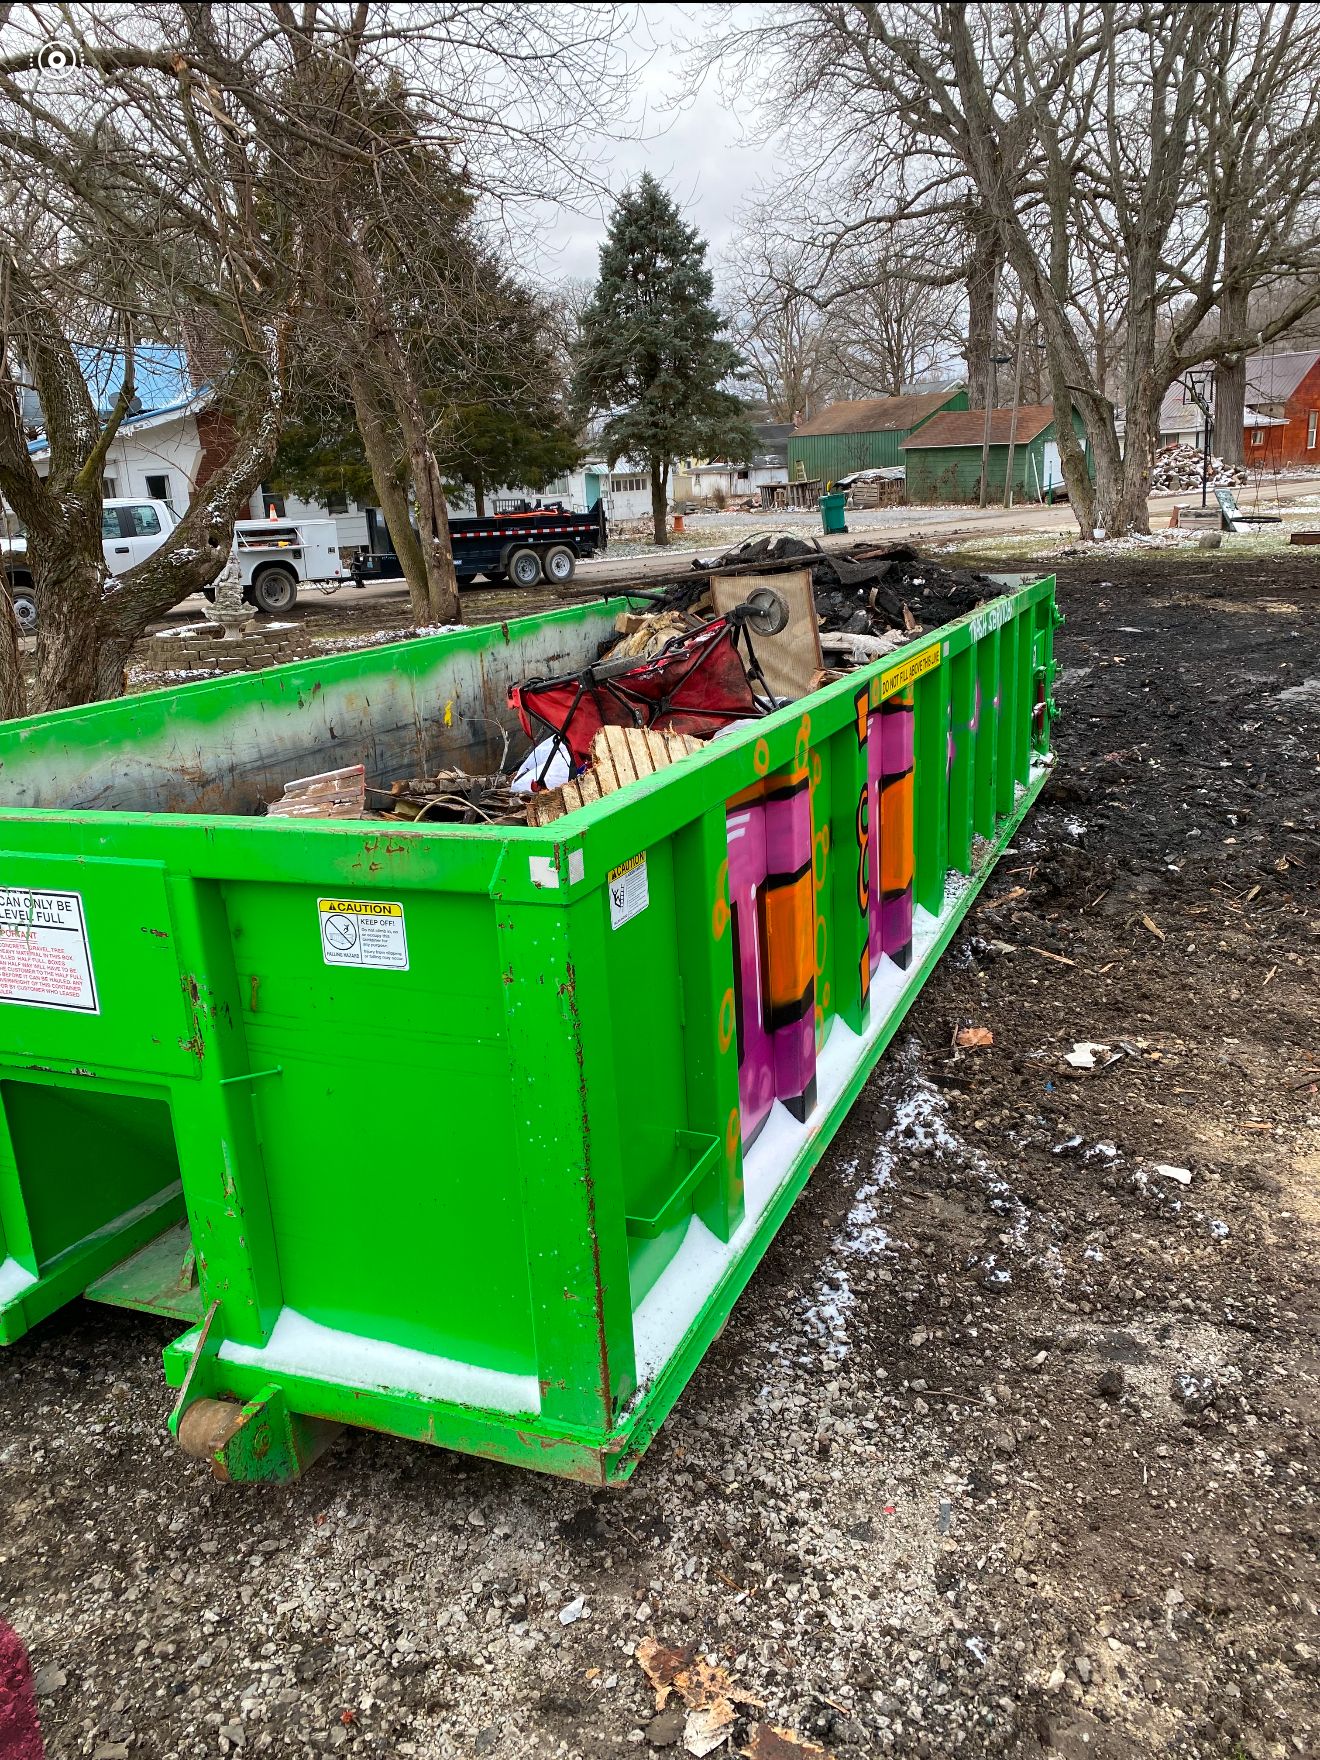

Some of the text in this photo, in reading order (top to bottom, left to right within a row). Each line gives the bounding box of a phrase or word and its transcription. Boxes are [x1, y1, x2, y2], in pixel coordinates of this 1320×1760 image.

[882, 650, 940, 694] DO NOT FILL ABOVE THIS LINE
[616, 850, 645, 876] CAUTION
[0, 896, 72, 912] CAN ONLY BE
[337, 903, 392, 914] CAUTION
[36, 912, 64, 924] FULL
